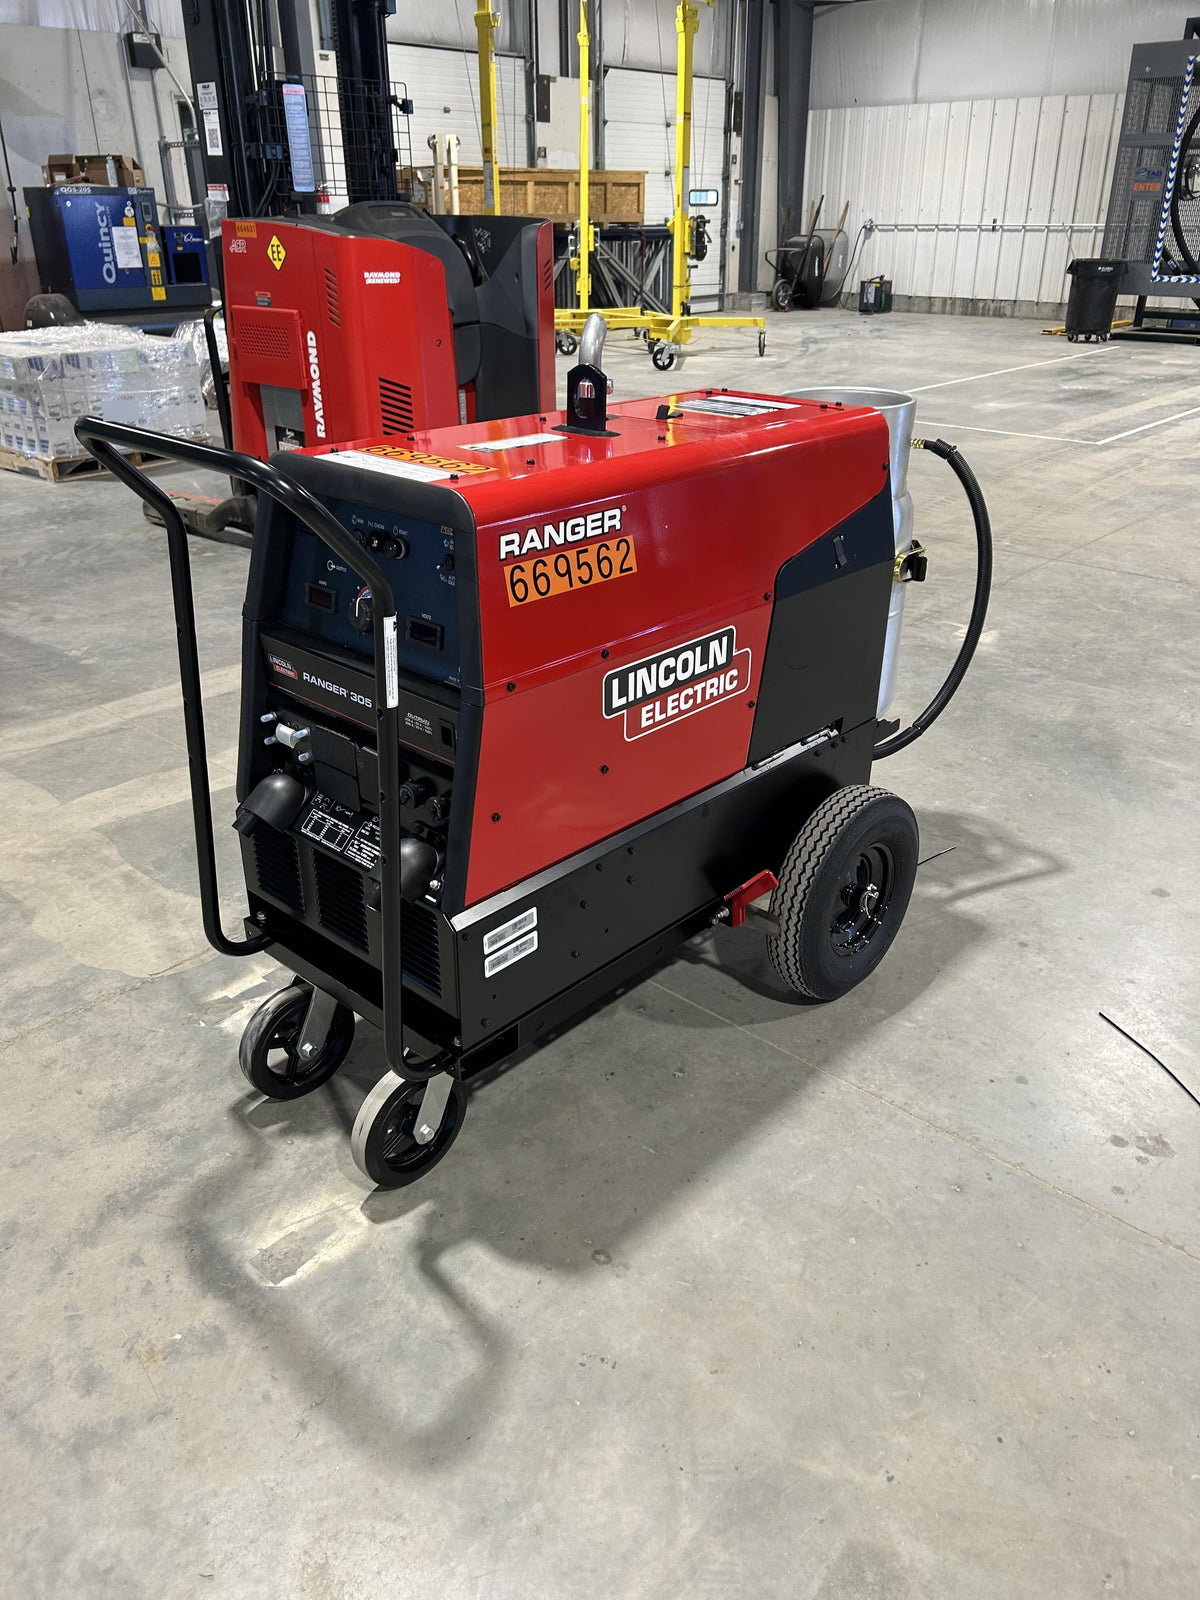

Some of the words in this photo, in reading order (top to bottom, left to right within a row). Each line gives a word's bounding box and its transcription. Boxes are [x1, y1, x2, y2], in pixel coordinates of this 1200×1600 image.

[1133, 182, 1161, 191] ENTER
[271, 244, 282, 261] EE
[306, 331, 326, 438] RAYMOND
[365, 447, 490, 474] 669562
[499, 508, 621, 560] RANGER
[508, 538, 634, 603] 669562
[269, 655, 293, 671] LINCOLN
[612, 636, 728, 708] LINCOLN
[303, 672, 348, 698] RANGER
[350, 691, 372, 708] 305
[641, 669, 738, 728] ELECTRIC
